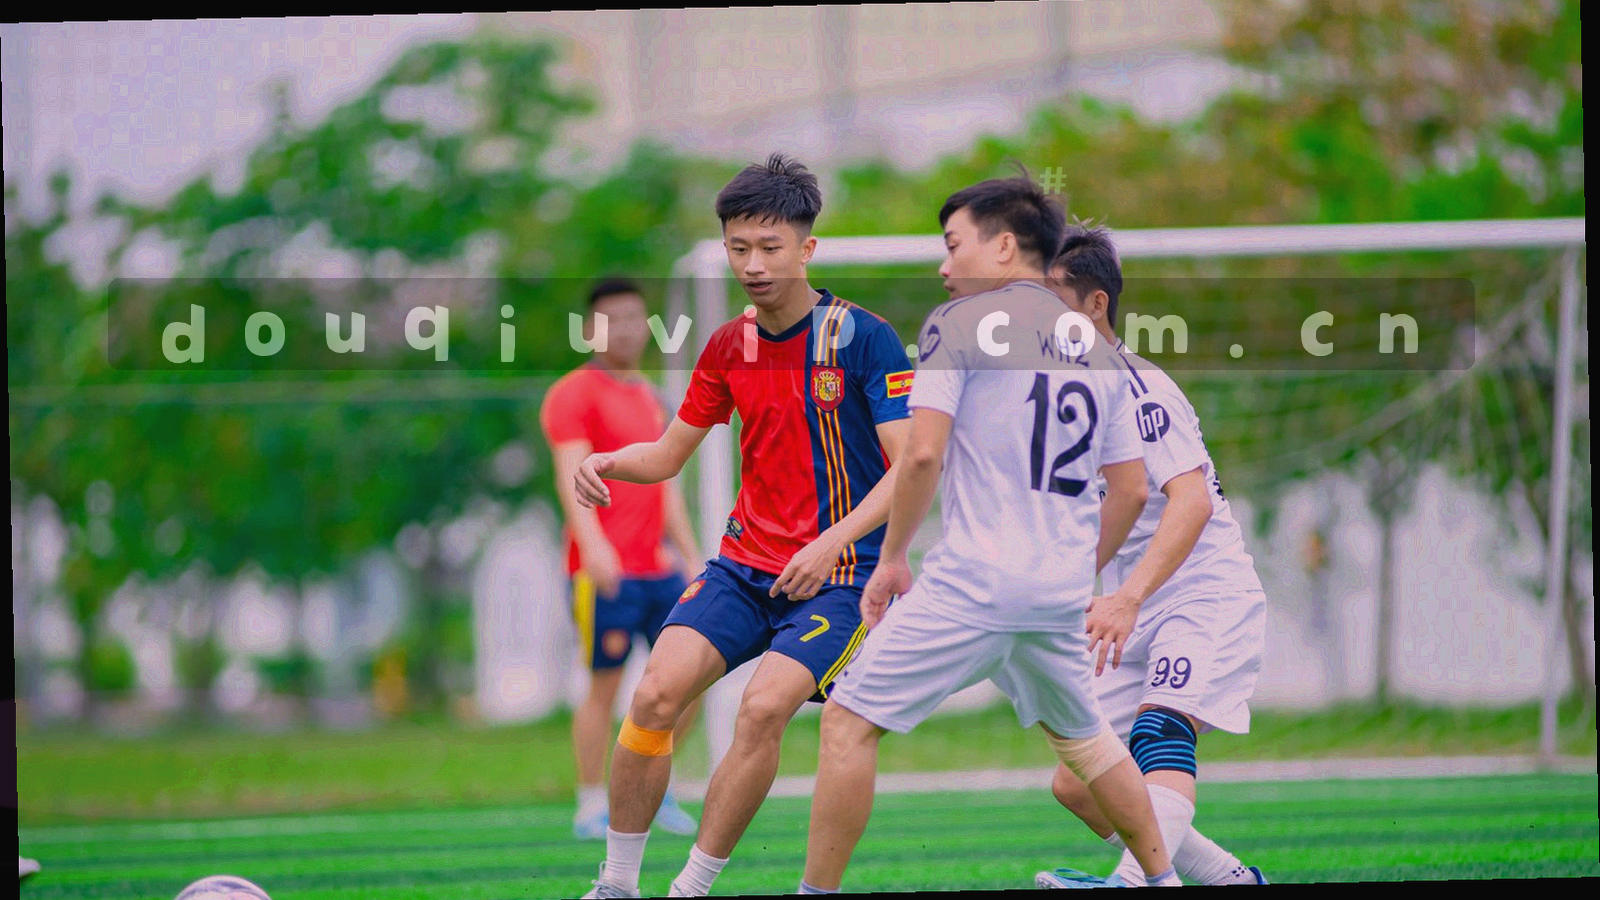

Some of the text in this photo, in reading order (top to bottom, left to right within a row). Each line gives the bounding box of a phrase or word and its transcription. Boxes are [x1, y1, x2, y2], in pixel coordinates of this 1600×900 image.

[1025, 372, 1099, 498] 12
[1137, 402, 1169, 442] hp
[799, 614, 831, 642] 7
[1151, 656, 1192, 689] 99
